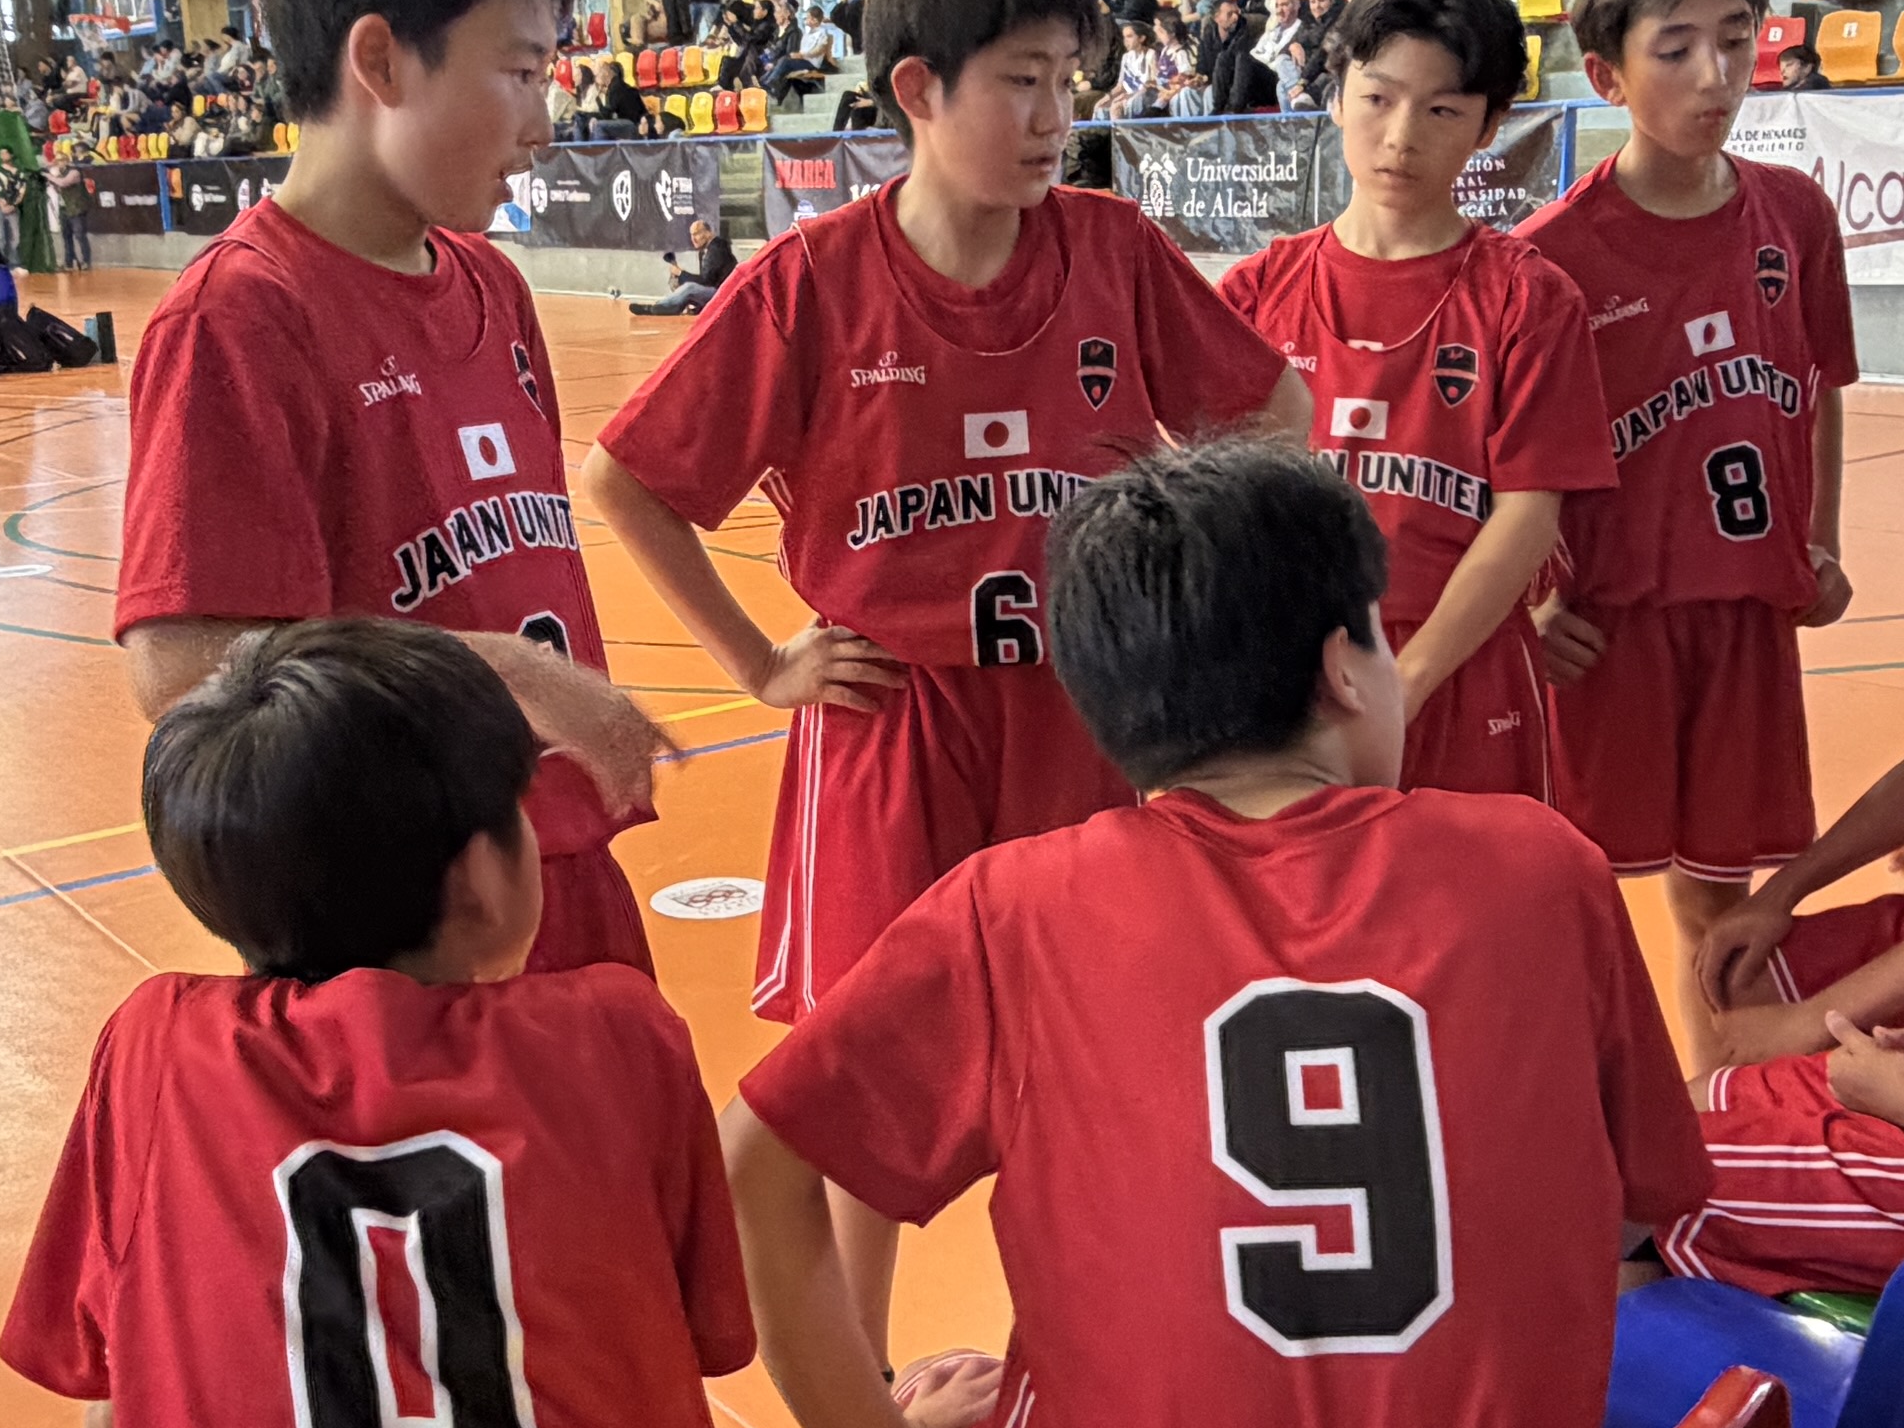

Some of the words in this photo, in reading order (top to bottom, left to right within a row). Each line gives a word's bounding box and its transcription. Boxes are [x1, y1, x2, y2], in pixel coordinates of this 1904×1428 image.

[1183, 188, 1206, 217] de
[1209, 190, 1269, 218] Alcalá
[1186, 151, 1298, 183] Universidad
[1453, 187, 1527, 202] ERSIDAD
[851, 365, 926, 388] SPALDING
[1610, 366, 1714, 463] JAPAN
[846, 473, 997, 551] JAPAN
[1702, 440, 1774, 542] 8
[970, 570, 1044, 667] 6
[1204, 976, 1454, 1358] 9
